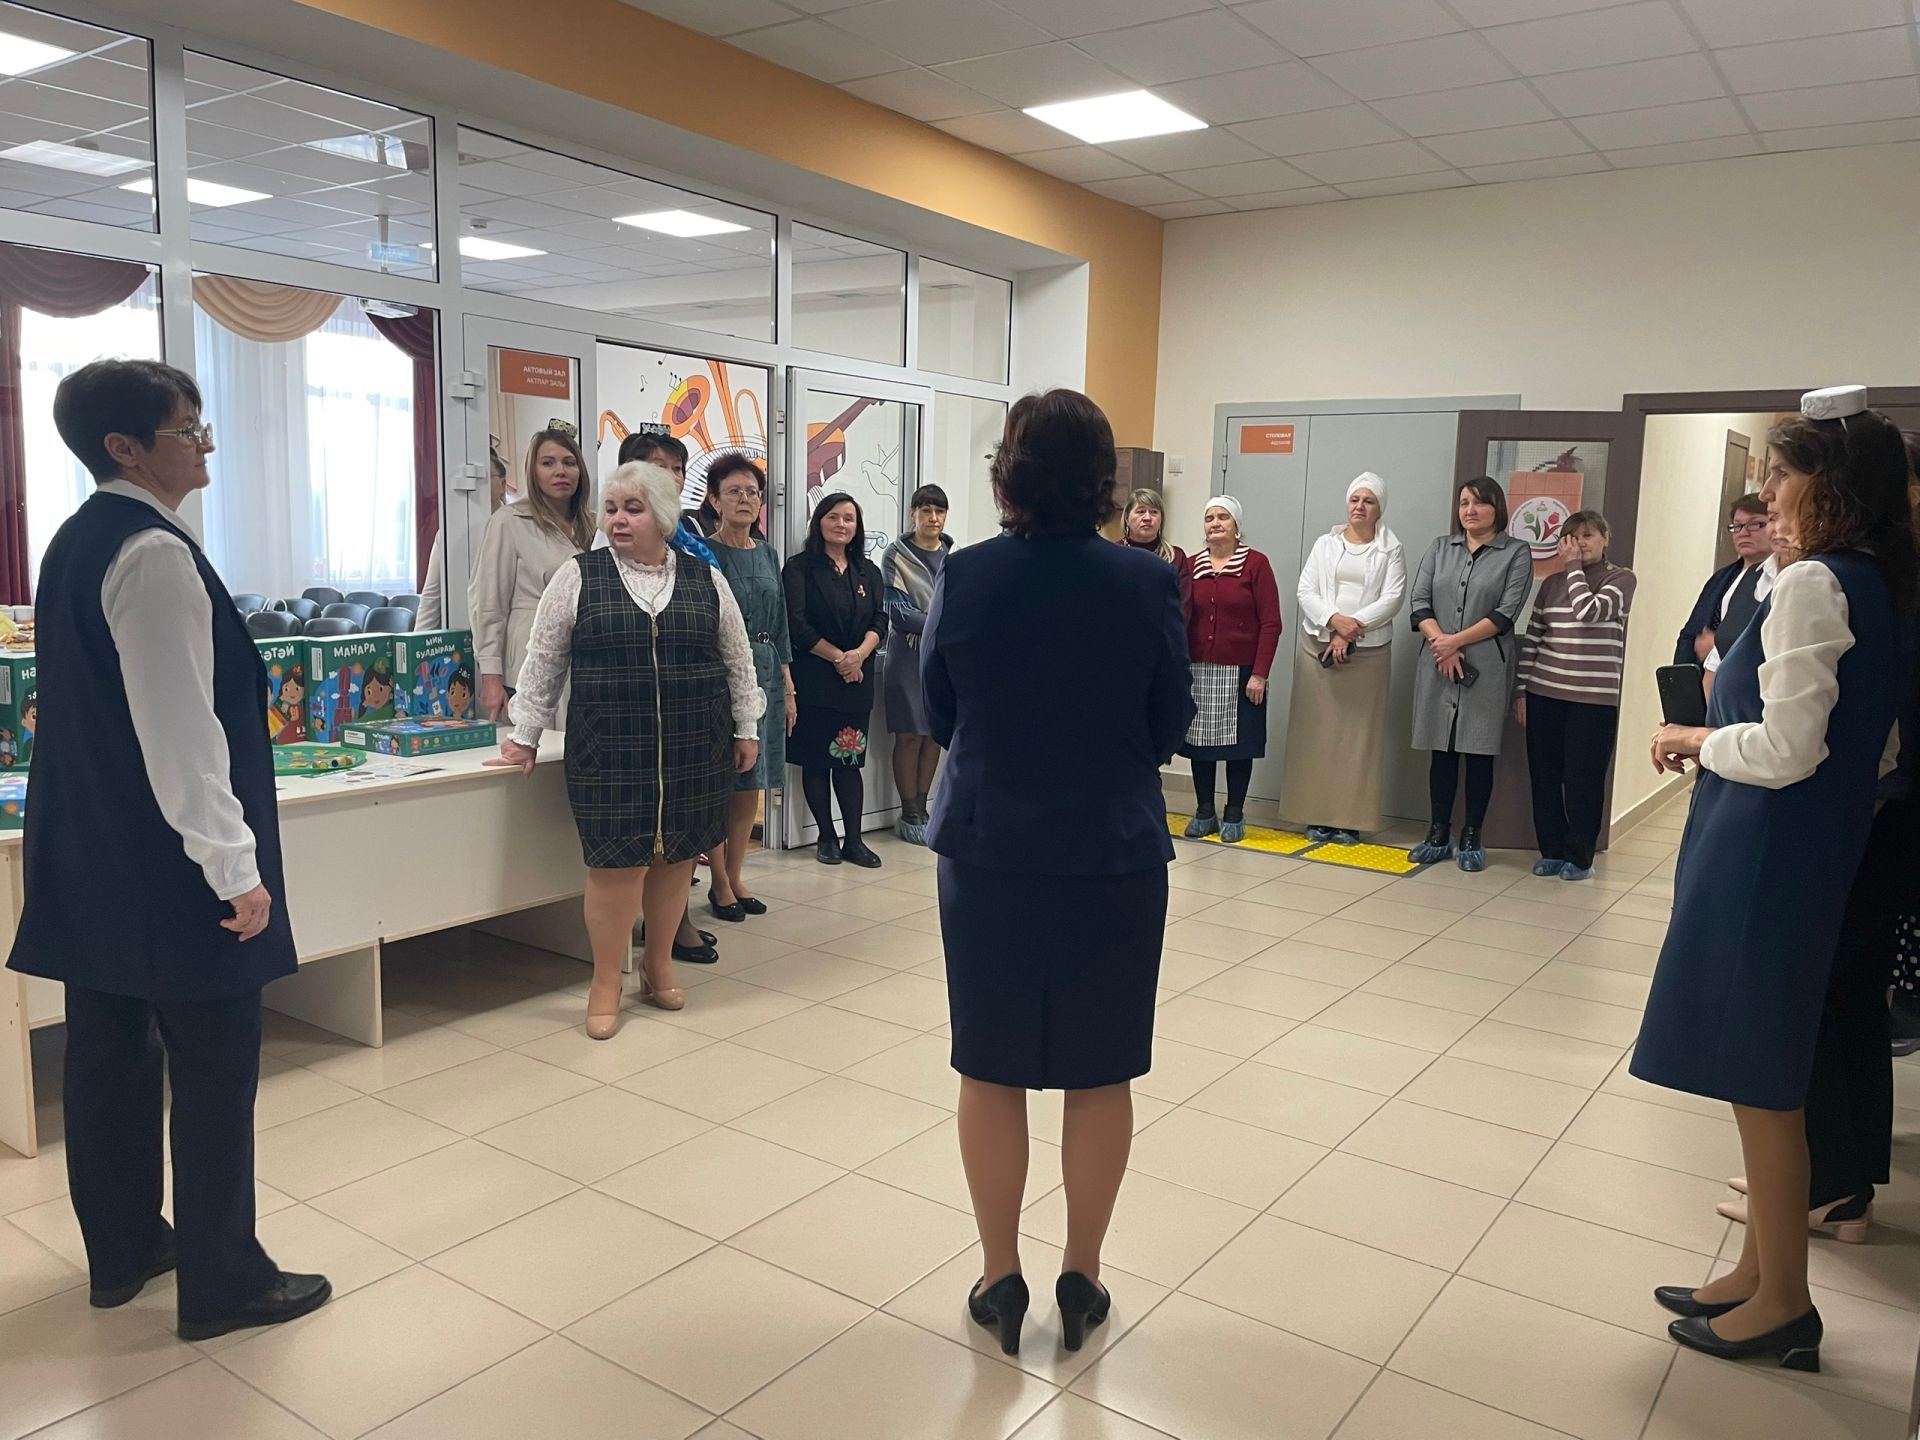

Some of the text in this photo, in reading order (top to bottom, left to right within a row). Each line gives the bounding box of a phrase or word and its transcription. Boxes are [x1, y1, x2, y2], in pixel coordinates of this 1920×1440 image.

[523, 366, 553, 375] АКТОВЫЙ
[425, 636, 443, 647] МИН
[333, 642, 376, 658] МАНАРА
[416, 644, 455, 659] БУЛДЫРАМ
